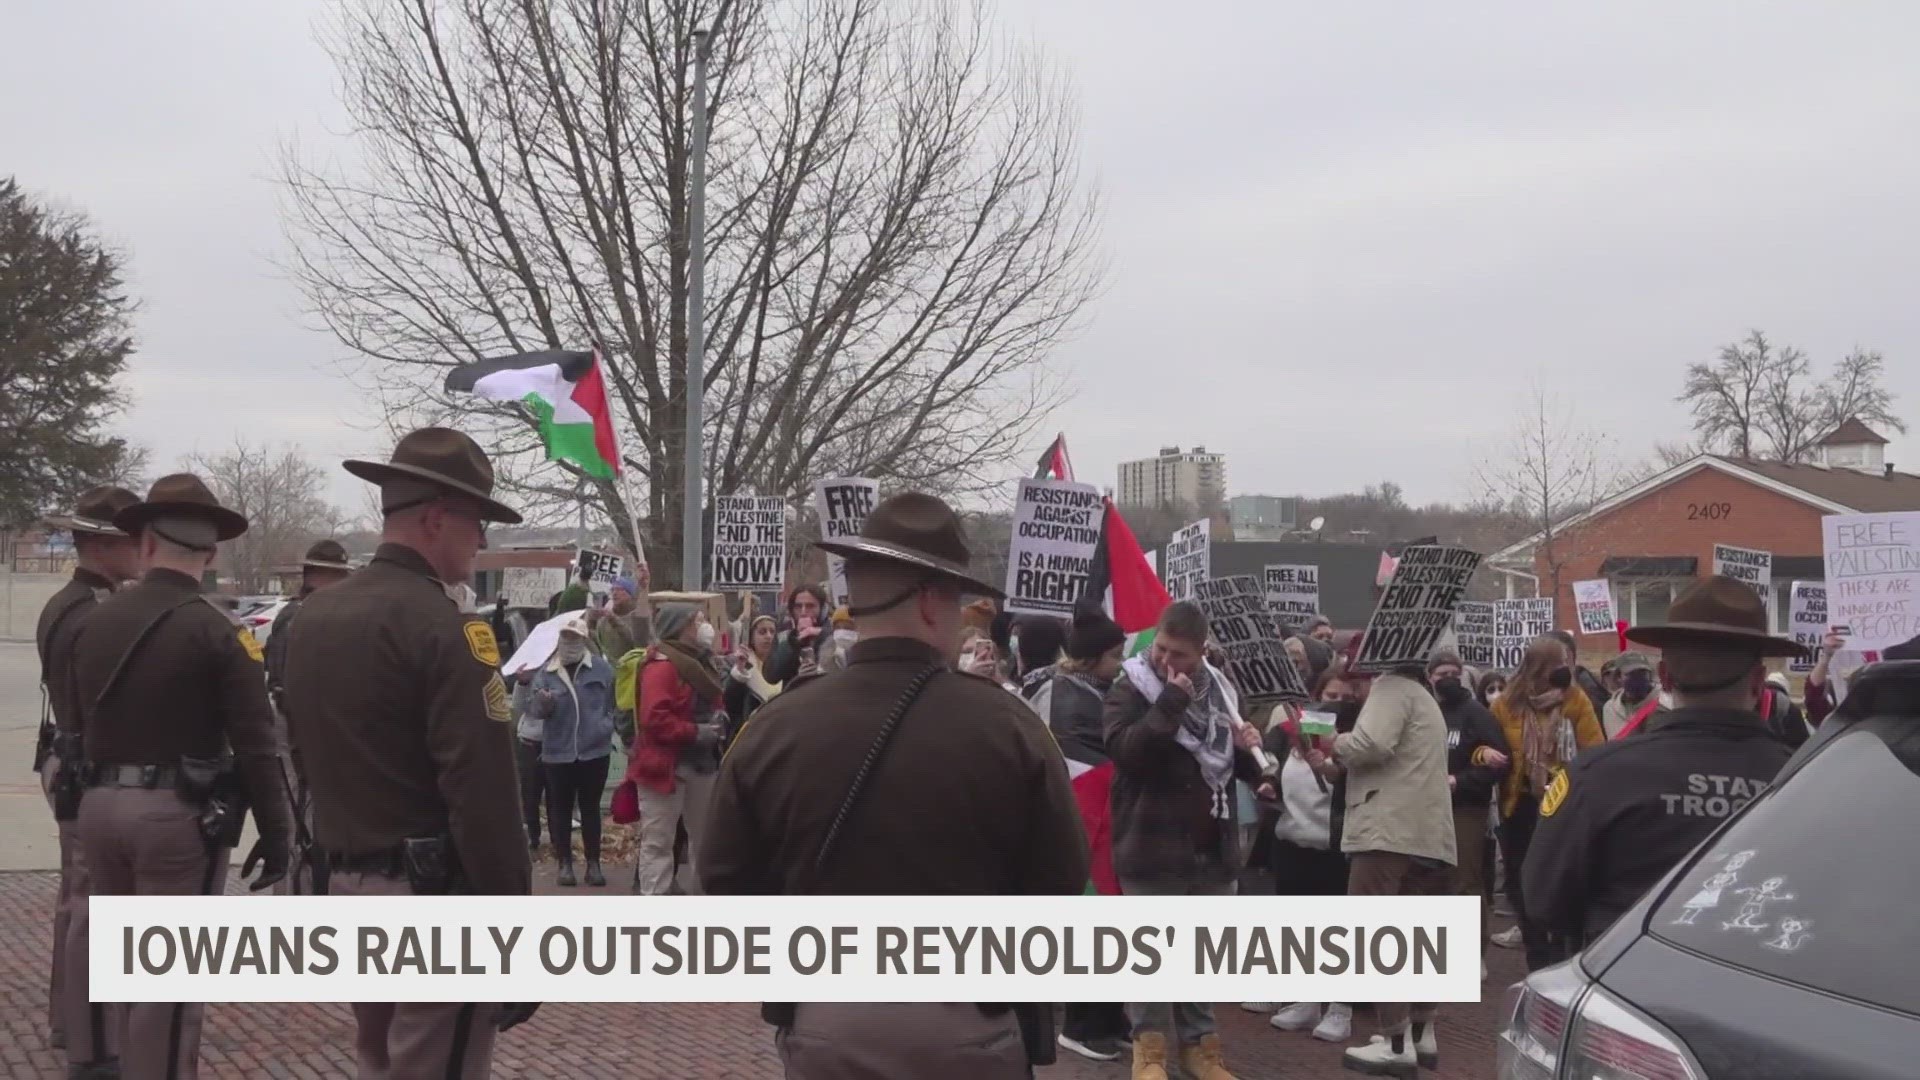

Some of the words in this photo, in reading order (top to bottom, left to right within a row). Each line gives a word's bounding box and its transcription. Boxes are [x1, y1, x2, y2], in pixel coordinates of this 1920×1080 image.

[717, 498, 754, 510] STAND
[757, 498, 784, 510] WITH
[825, 485, 874, 519] FREE
[1687, 502, 1731, 520] 2409
[717, 511, 784, 524] PALESTINE!
[1034, 505, 1091, 526] AGAINST
[717, 525, 751, 543] END
[755, 525, 783, 542] THE
[827, 519, 862, 537] PALE
[1019, 521, 1100, 545] OCCUPATION
[1838, 521, 1906, 547] FREE
[715, 544, 782, 557] OCCUPATION
[1019, 551, 1032, 569] IS
[1034, 553, 1044, 570] A
[1401, 547, 1442, 565] STAND
[1443, 548, 1482, 569] WITH
[1716, 547, 1770, 568] RESISTANCE
[579, 550, 620, 575] REE
[715, 557, 781, 583] NOW!
[1721, 563, 1760, 581] AGAINST
[1015, 569, 1090, 603] RIGHT
[1266, 569, 1295, 582] FREE
[1297, 570, 1316, 584] ALL
[1393, 565, 1473, 588] PALESTINE!
[1196, 579, 1234, 601] STAND
[1381, 584, 1424, 610] END
[1423, 584, 1465, 611] THE
[1839, 581, 1879, 598] THESE
[1496, 600, 1525, 611] STAND
[1527, 599, 1553, 609] WITH
[1211, 616, 1251, 643] END
[1373, 610, 1451, 629] OCCUPATION
[1496, 622, 1523, 637] END
[1527, 621, 1552, 635] THE
[1359, 626, 1441, 660] NOW!
[1496, 636, 1534, 648] OCCUPA
[1458, 645, 1494, 662] RIGH
[1496, 647, 1525, 668] NO
[1688, 773, 1772, 797] STAT
